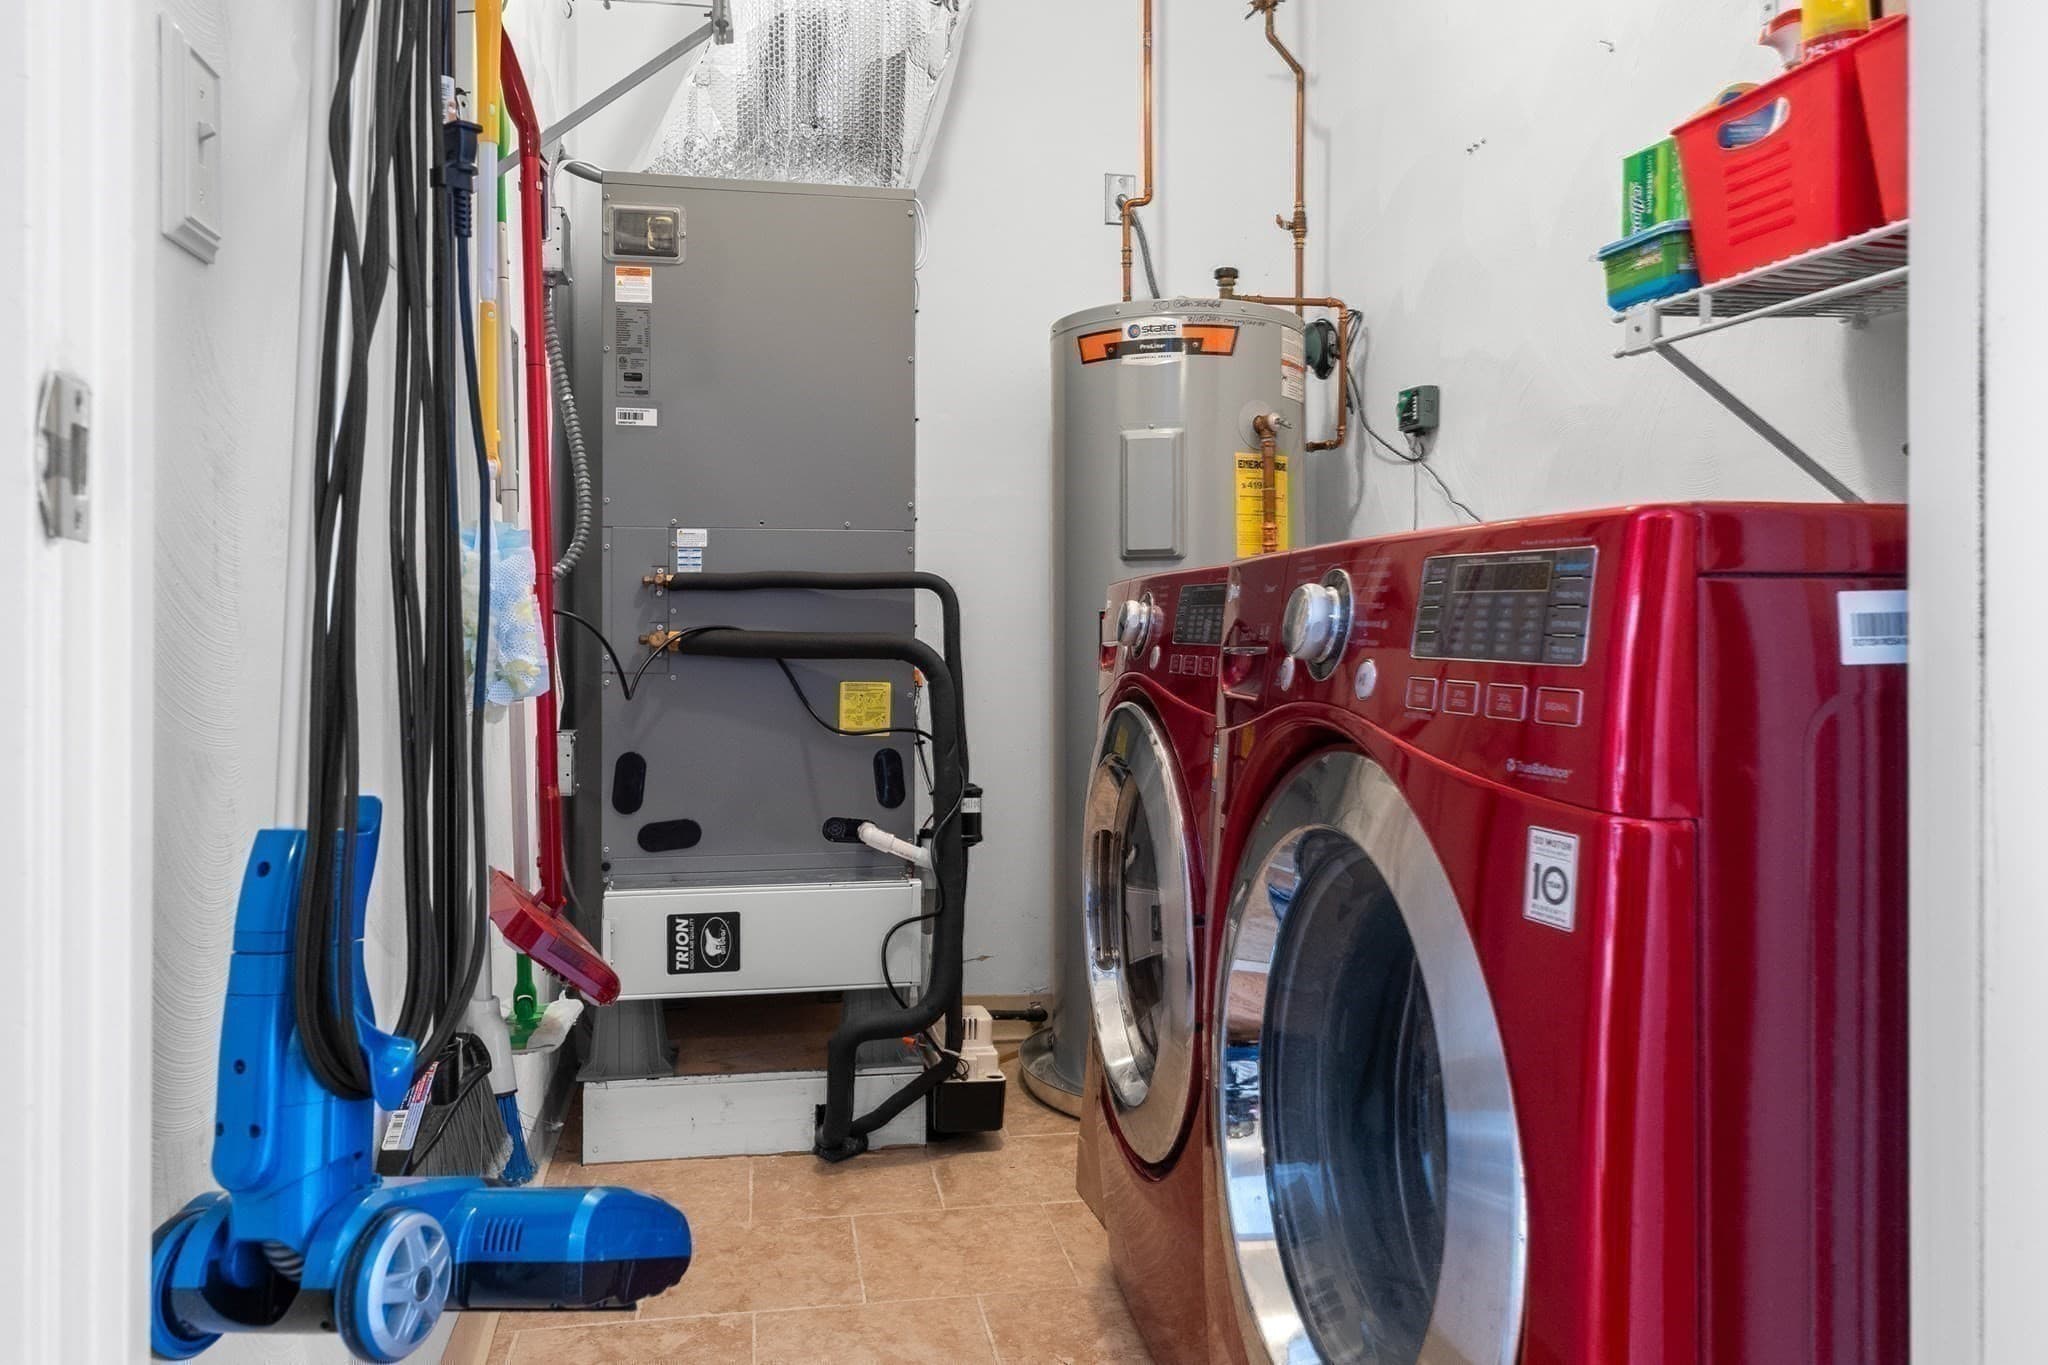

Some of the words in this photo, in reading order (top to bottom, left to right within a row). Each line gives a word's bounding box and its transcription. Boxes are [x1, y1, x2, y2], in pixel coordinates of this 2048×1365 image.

[1141, 323, 1177, 333] state
[1533, 863, 1568, 905] 10
[675, 918, 689, 971] TRION
